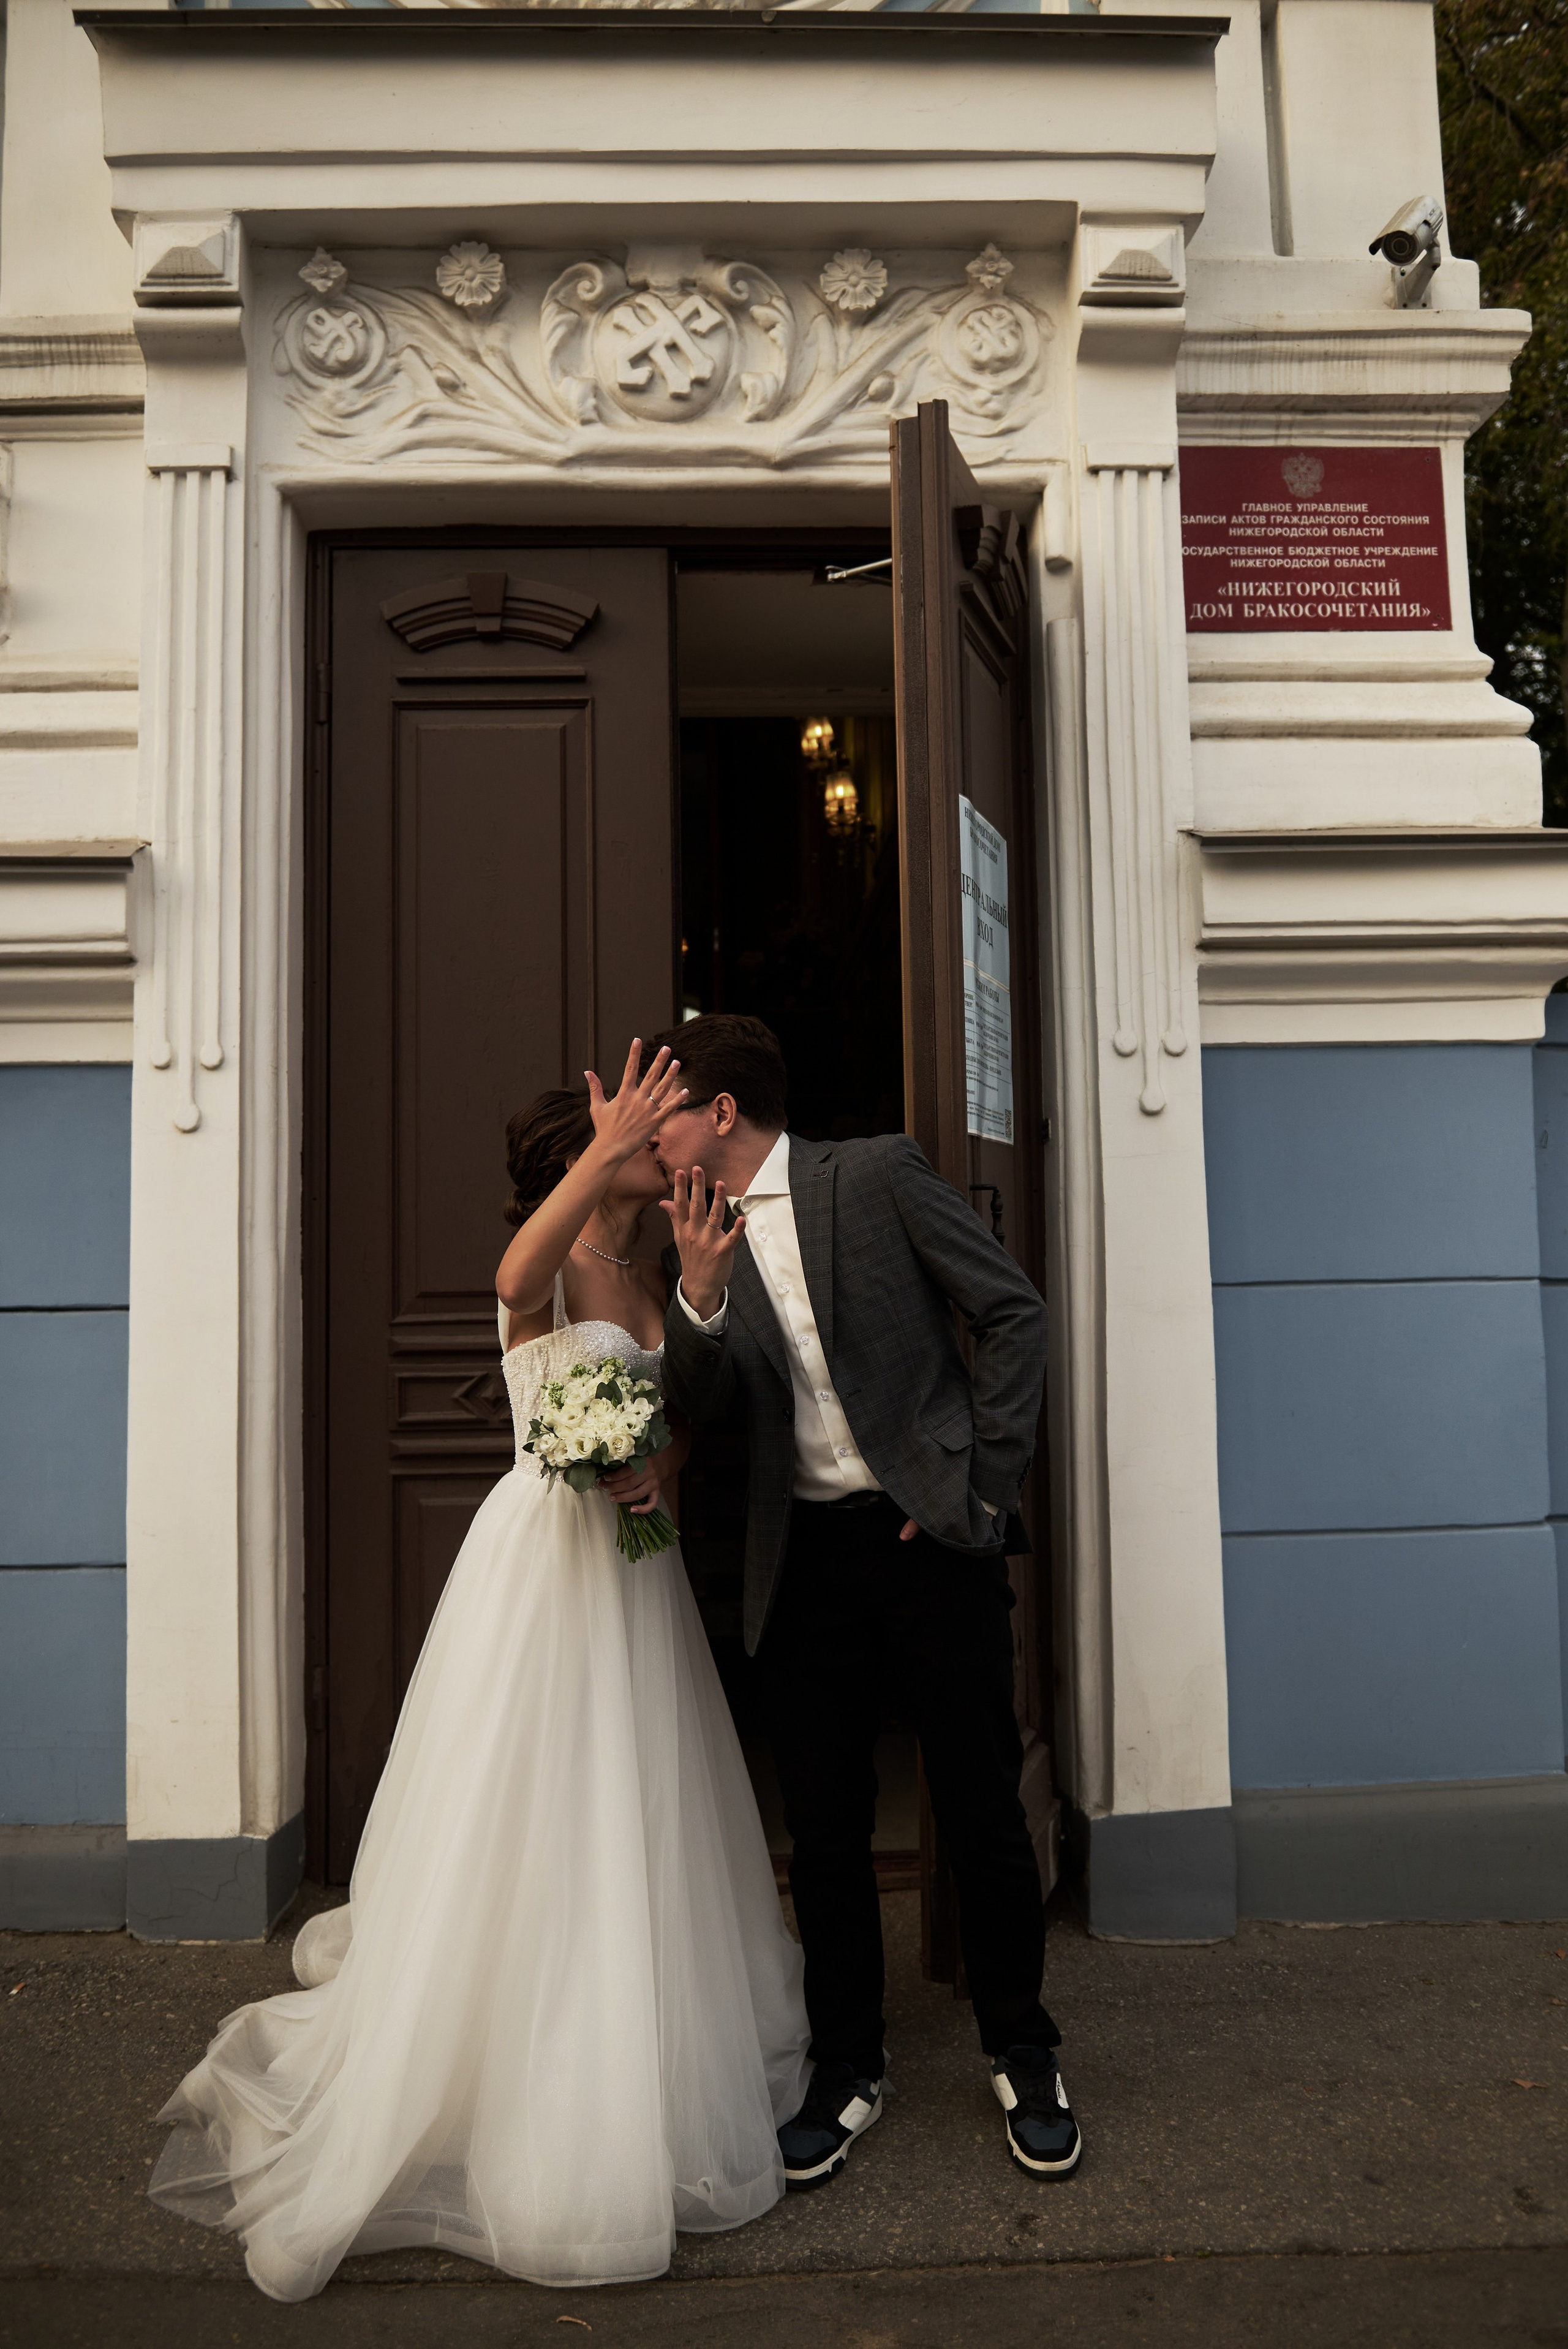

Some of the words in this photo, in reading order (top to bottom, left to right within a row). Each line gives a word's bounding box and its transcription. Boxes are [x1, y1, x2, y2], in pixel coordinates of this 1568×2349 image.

[1242, 503, 1292, 513] ГЛАВНОЕ
[1297, 503, 1368, 513] УПРАВЛЕНИЕ
[1182, 515, 1226, 524] ЗАПИСИ
[1231, 515, 1266, 524] АКТОВ
[1270, 515, 1359, 525] ГРАЖДАНСКОГО
[1363, 516, 1430, 524] СОСТОЯНИЯ
[1229, 526, 1328, 537] НИЖЕГОРОДСКОЙ
[1333, 528, 1384, 537] ОБЛАСТИ
[1183, 546, 1284, 556] ОСУДАРСТВЕННОЕ
[1288, 546, 1360, 556] БЮДЖЕТНОЕ
[1364, 547, 1438, 556] УЧРЕЖДЕНИЕ
[1230, 557, 1330, 568] НИЖЕГОРОДСКОЙ
[1334, 559, 1385, 567] ОБЛАСТИ
[1218, 579, 1401, 597] «НИЖЕГОРОДСКИЙ
[1189, 603, 1233, 621] ДОМ
[1243, 603, 1431, 618] БРАКОСОЧЕТАНИЯ»
[977, 917, 993, 950] ВХОД
